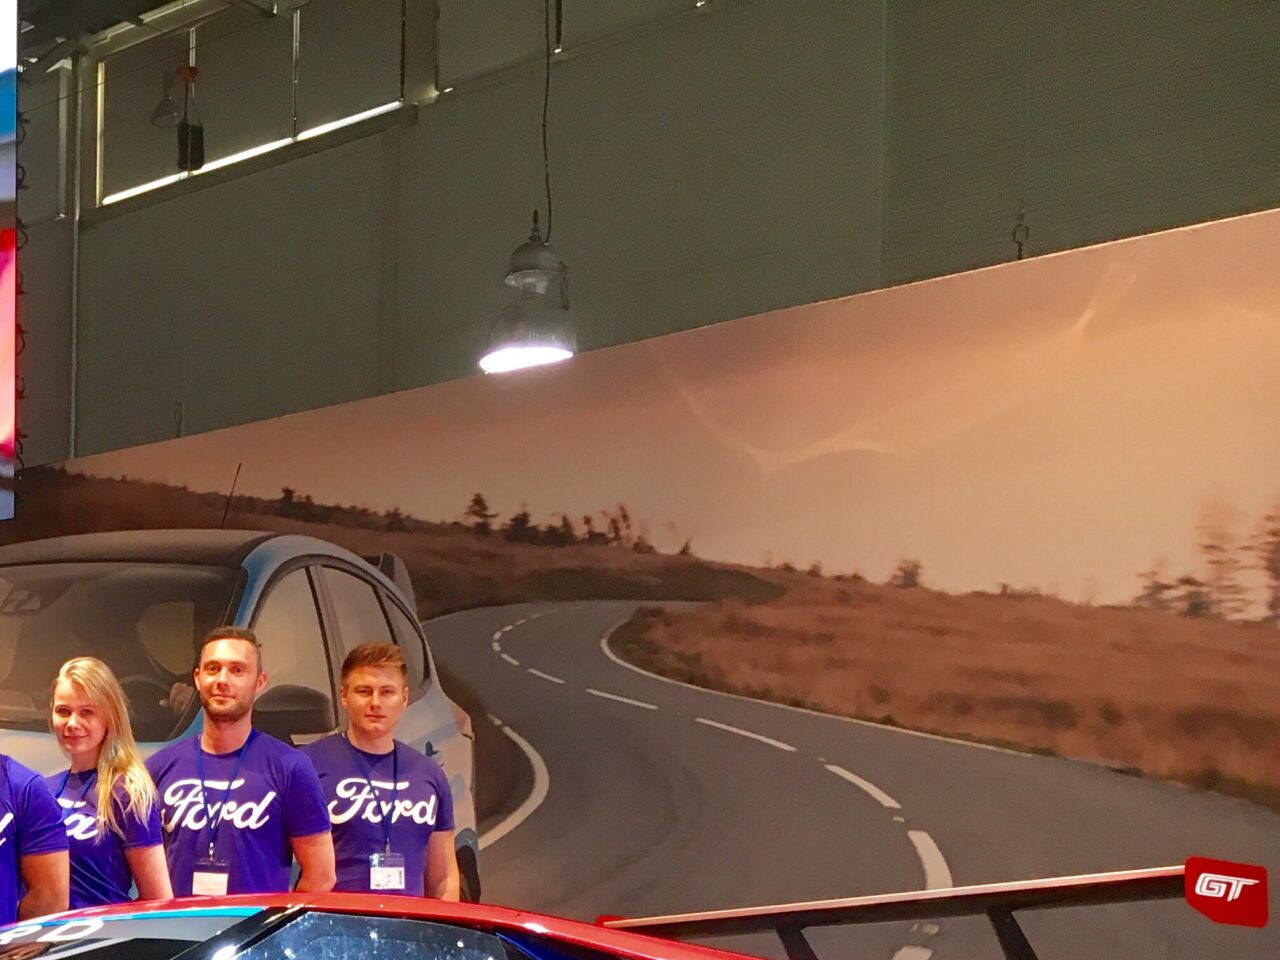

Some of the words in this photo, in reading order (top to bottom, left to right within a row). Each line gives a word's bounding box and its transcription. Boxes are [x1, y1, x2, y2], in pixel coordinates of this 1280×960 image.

[161, 778, 277, 832] Ford
[328, 777, 437, 826] Ford
[1194, 872, 1261, 902] GT
